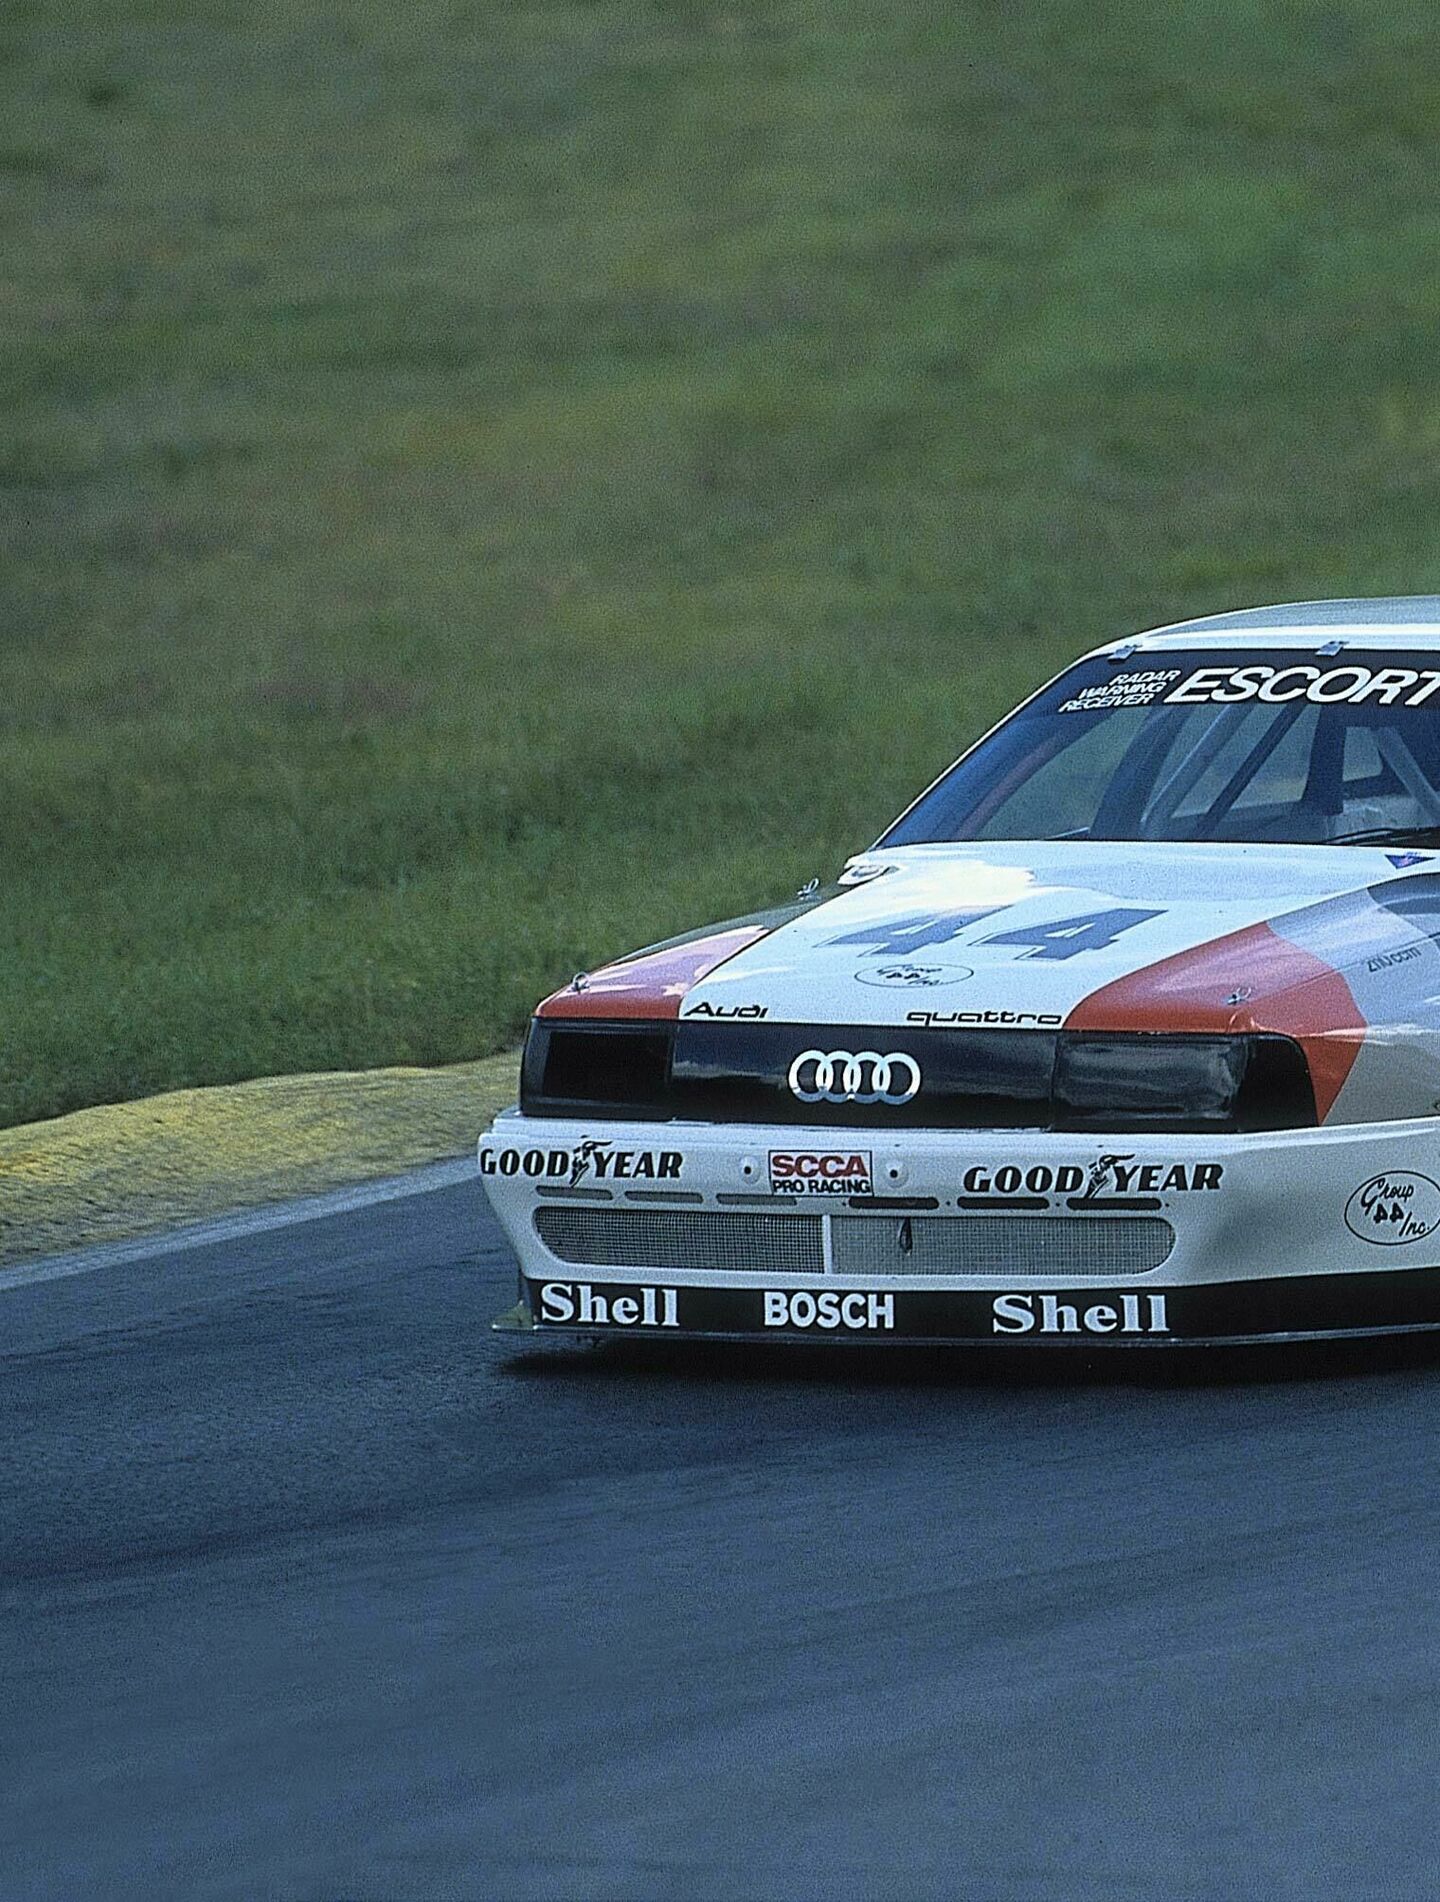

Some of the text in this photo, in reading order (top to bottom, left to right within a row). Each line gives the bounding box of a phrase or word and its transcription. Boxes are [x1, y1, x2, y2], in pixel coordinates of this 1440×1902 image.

[1109, 669, 1182, 686] RADAR
[1057, 693, 1155, 713] RECEIVER
[1078, 682, 1168, 699] WARNING
[810, 904, 1169, 961] 44
[684, 1001, 1063, 1027] Audi quattro
[772, 1154, 869, 1178] SCCA
[773, 1179, 871, 1194] PRO RACING
[1360, 1177, 1415, 1217] Group
[1373, 1201, 1405, 1224] 44
[540, 1283, 680, 1327] Shell
[763, 1291, 895, 1330] BOSCH
[992, 1294, 1171, 1334] Shell
